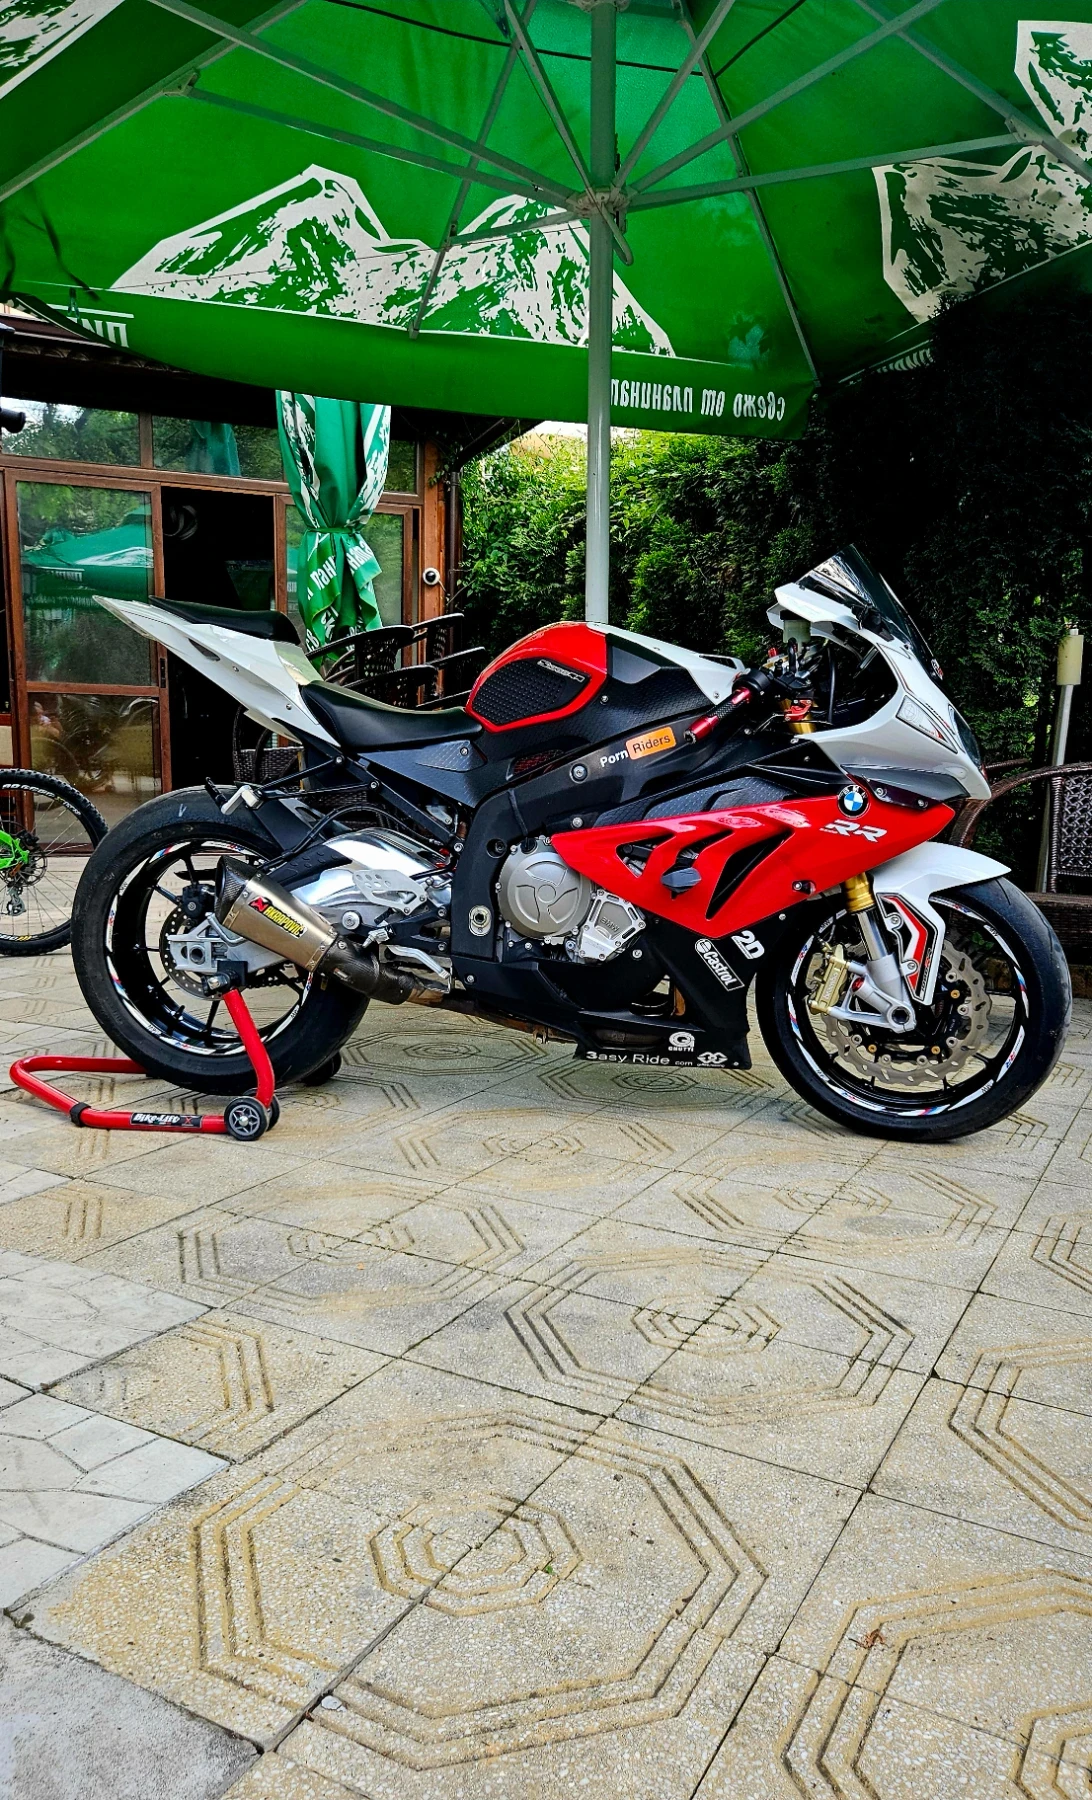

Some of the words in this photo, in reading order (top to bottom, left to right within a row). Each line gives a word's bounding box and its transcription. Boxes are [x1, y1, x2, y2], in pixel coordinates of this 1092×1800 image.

[599, 749, 629, 768] Porn
[632, 734, 671, 754] Riders
[825, 819, 888, 843] RR
[703, 950, 738, 986] Castrol
[586, 1050, 628, 1063] 3asy
[632, 1053, 670, 1065] Ride
